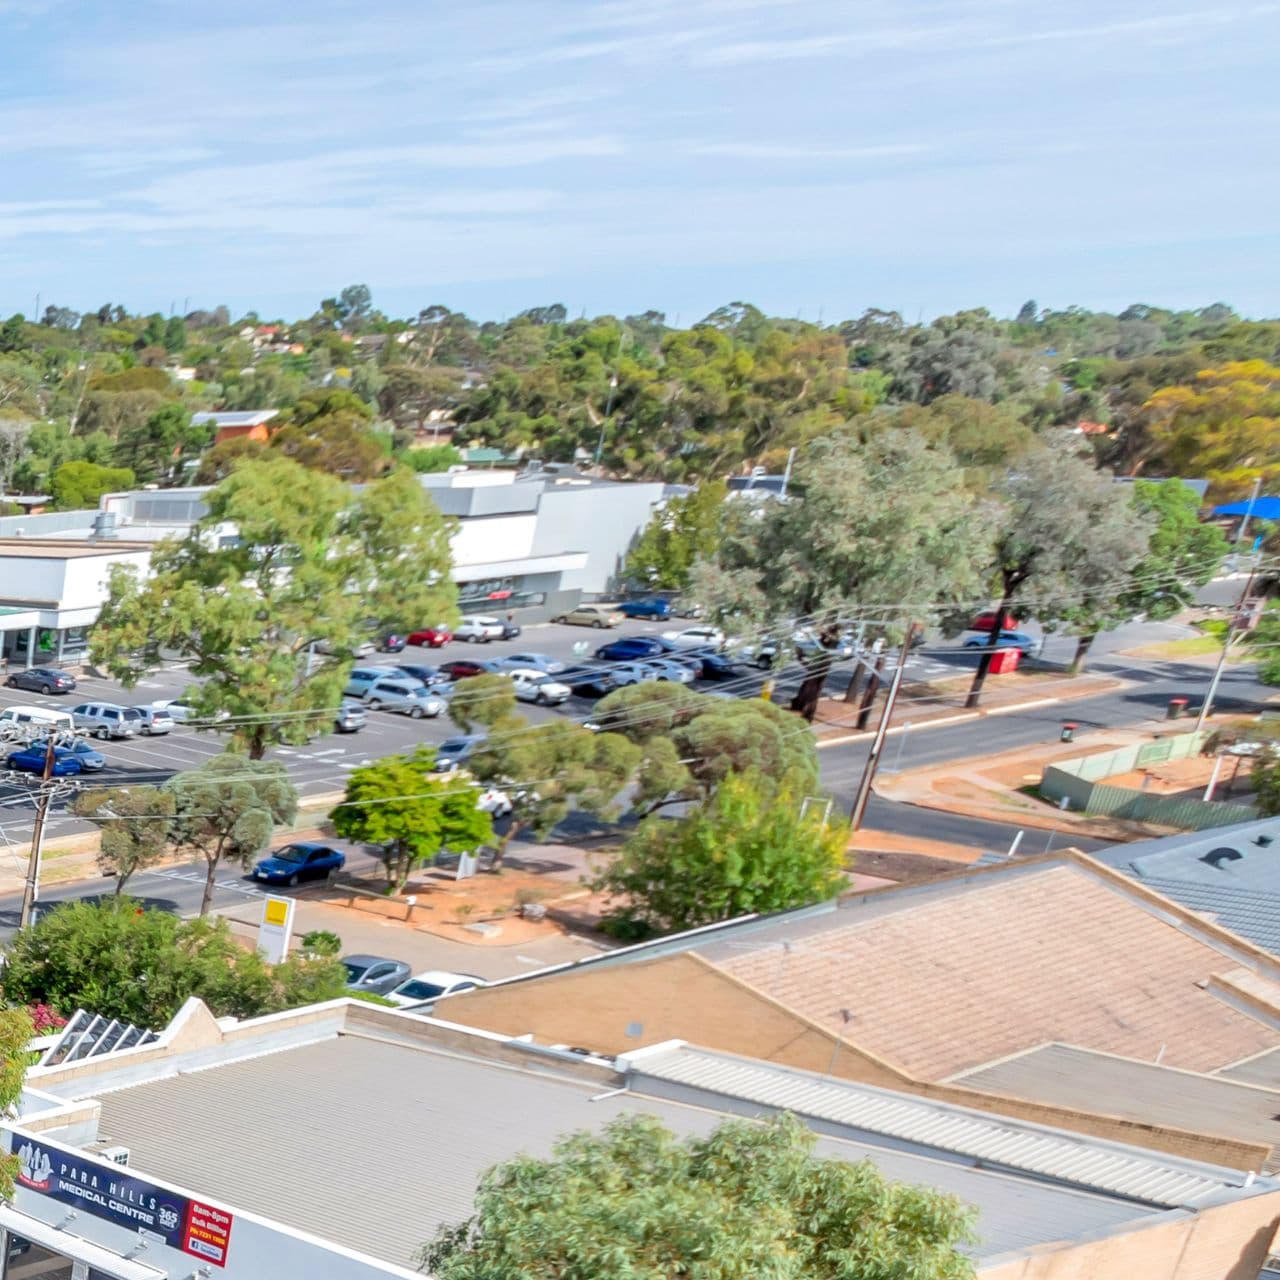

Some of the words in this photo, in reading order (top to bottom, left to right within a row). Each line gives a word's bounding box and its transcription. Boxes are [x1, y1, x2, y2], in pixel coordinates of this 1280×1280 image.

[60, 1164, 98, 1188] PARA
[109, 1182, 157, 1210] HILLS
[59, 1180, 107, 1206] MEDICAL
[109, 1199, 154, 1225] CENTRE
[159, 1207, 178, 1223] 365
[159, 1217, 175, 1229] DAYS
[191, 1216, 206, 1228] Bulk
